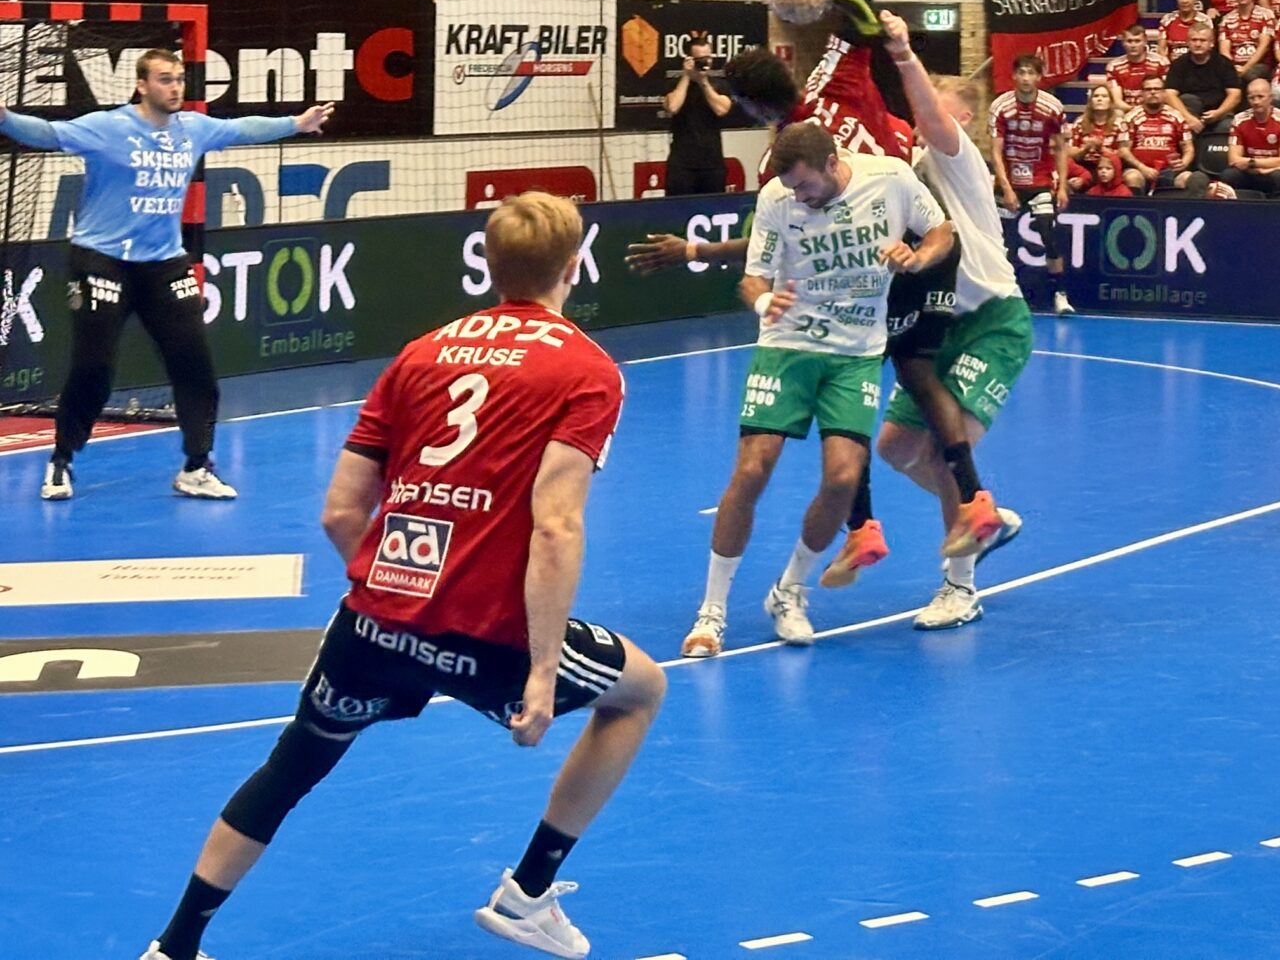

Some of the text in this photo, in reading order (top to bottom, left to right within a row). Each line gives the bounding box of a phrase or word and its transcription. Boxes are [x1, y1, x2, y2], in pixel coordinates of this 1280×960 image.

[445, 24, 608, 55] KRAFT BILER
[130, 150, 192, 170] SKJERN
[135, 169, 188, 187] BANK
[130, 196, 184, 214] VELU
[799, 220, 889, 255] SKJERN
[812, 246, 882, 273] BANK
[1100, 283, 1207, 307] Emballage
[796, 314, 831, 339] 25
[260, 328, 356, 359] Emballage
[436, 346, 528, 367] KRUSE
[418, 373, 492, 467] 3
[375, 570, 434, 589] DANMARK
